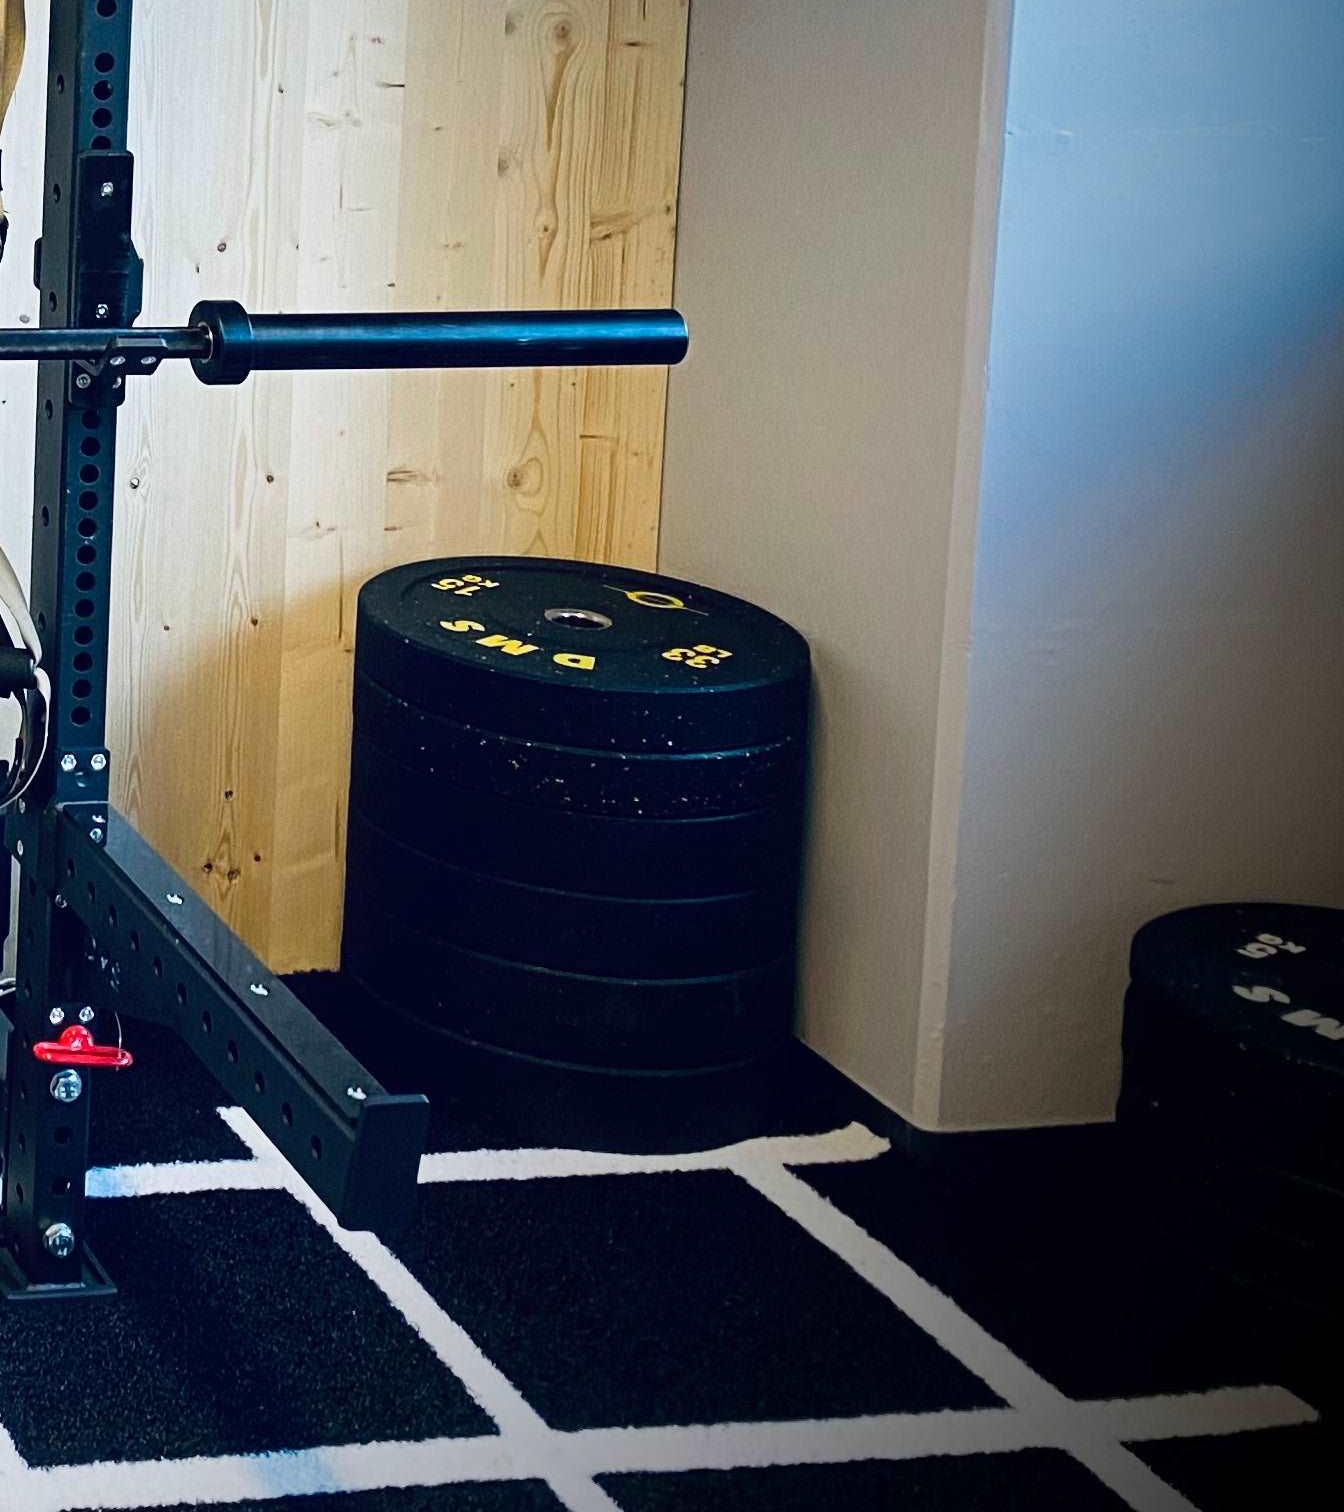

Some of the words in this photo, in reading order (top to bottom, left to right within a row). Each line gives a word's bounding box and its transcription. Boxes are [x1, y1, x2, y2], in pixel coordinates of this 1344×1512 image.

[431, 578, 481, 596] 15
[439, 619, 596, 670] DMS
[661, 648, 720, 669] 33
